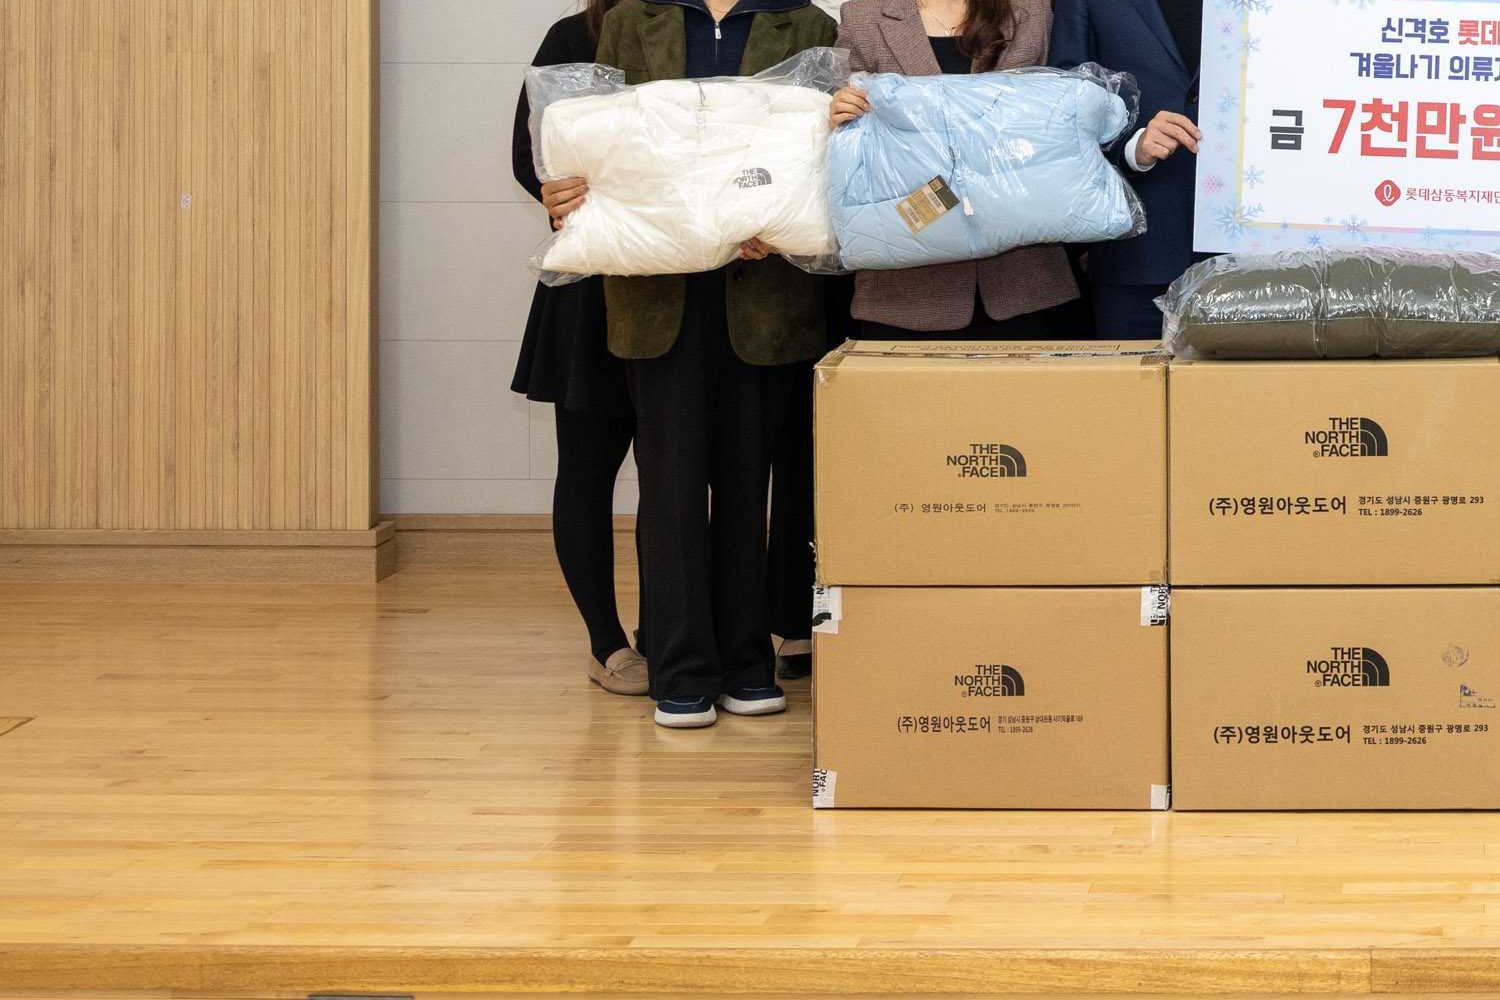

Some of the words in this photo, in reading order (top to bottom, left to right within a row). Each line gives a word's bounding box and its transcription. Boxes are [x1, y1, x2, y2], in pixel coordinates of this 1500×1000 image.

[1382, 18, 1449, 44] 신격호
[1350, 53, 1440, 79] 겨울나기
[1270, 110, 1304, 150] 금
[739, 181, 757, 189] FACE
[1329, 418, 1359, 430] THE
[1305, 431, 1359, 444] NORTH
[970, 444, 998, 454] THE
[947, 455, 998, 466] NORTH
[1209, 496, 1345, 515] (주)영원아웃도어
[1359, 496, 1383, 506] 경기도
[1386, 496, 1411, 506] 성남시
[1414, 496, 1439, 506] 중원구
[1442, 496, 1467, 506] 광명로
[1470, 495, 1485, 504] 293
[895, 504, 913, 513] (주)
[921, 503, 985, 513] 영원아웃도어
[1358, 508, 1373, 516] TEL
[1380, 508, 1423, 516] 1899-2626
[1331, 647, 1361, 660] THE
[975, 665, 1000, 675] THE
[1307, 661, 1361, 673] NORTH
[955, 676, 1000, 687] NORTH
[898, 716, 990, 733] (주)영원아웃도어
[1363, 725, 1388, 735] 경기도
[1391, 725, 1415, 734] 성남시
[1419, 725, 1444, 734] 중원구
[1446, 725, 1471, 734] 광명로
[1474, 724, 1489, 732] 293
[1214, 725, 1350, 744] (주)영원아웃도어
[1363, 737, 1377, 745] TEL
[1385, 736, 1427, 745] 1899-2626
